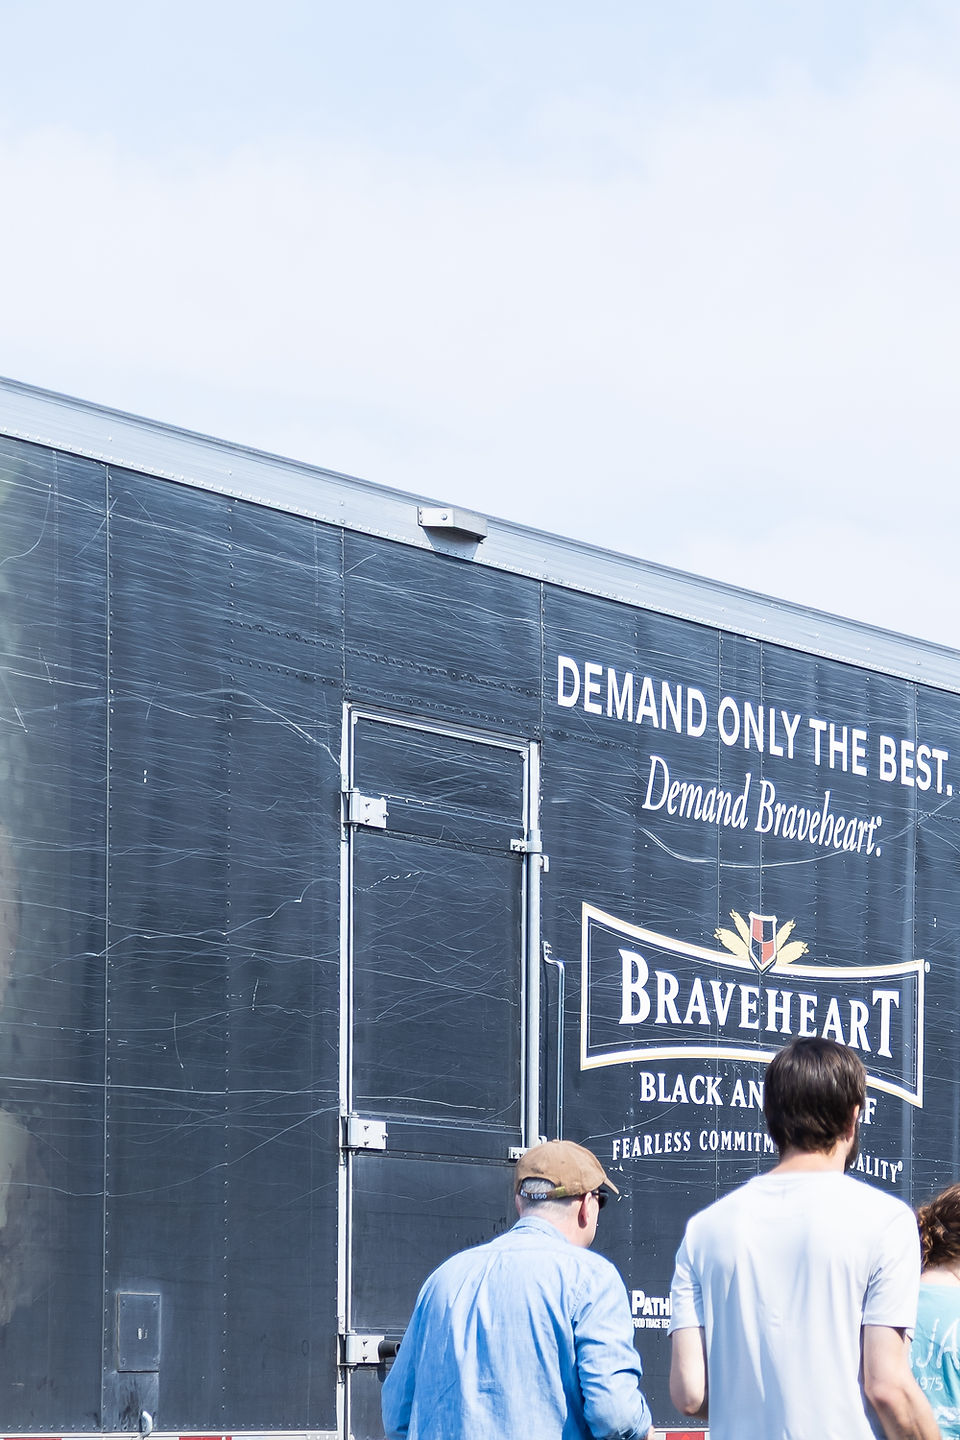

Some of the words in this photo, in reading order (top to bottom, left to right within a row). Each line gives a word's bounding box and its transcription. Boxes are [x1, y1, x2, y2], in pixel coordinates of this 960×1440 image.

[557, 655, 708, 738] DEMAND
[717, 696, 801, 759] ONLY
[809, 718, 868, 777] THE
[879, 735, 954, 796] BEST.
[642, 755, 752, 830] Demand
[618, 948, 900, 1059] BRAVEHEART
[639, 1072, 724, 1106] BLACK
[612, 1131, 692, 1161] FEARLESS
[699, 1130, 780, 1154] COMMITM
[917, 1377, 944, 1392] 975
